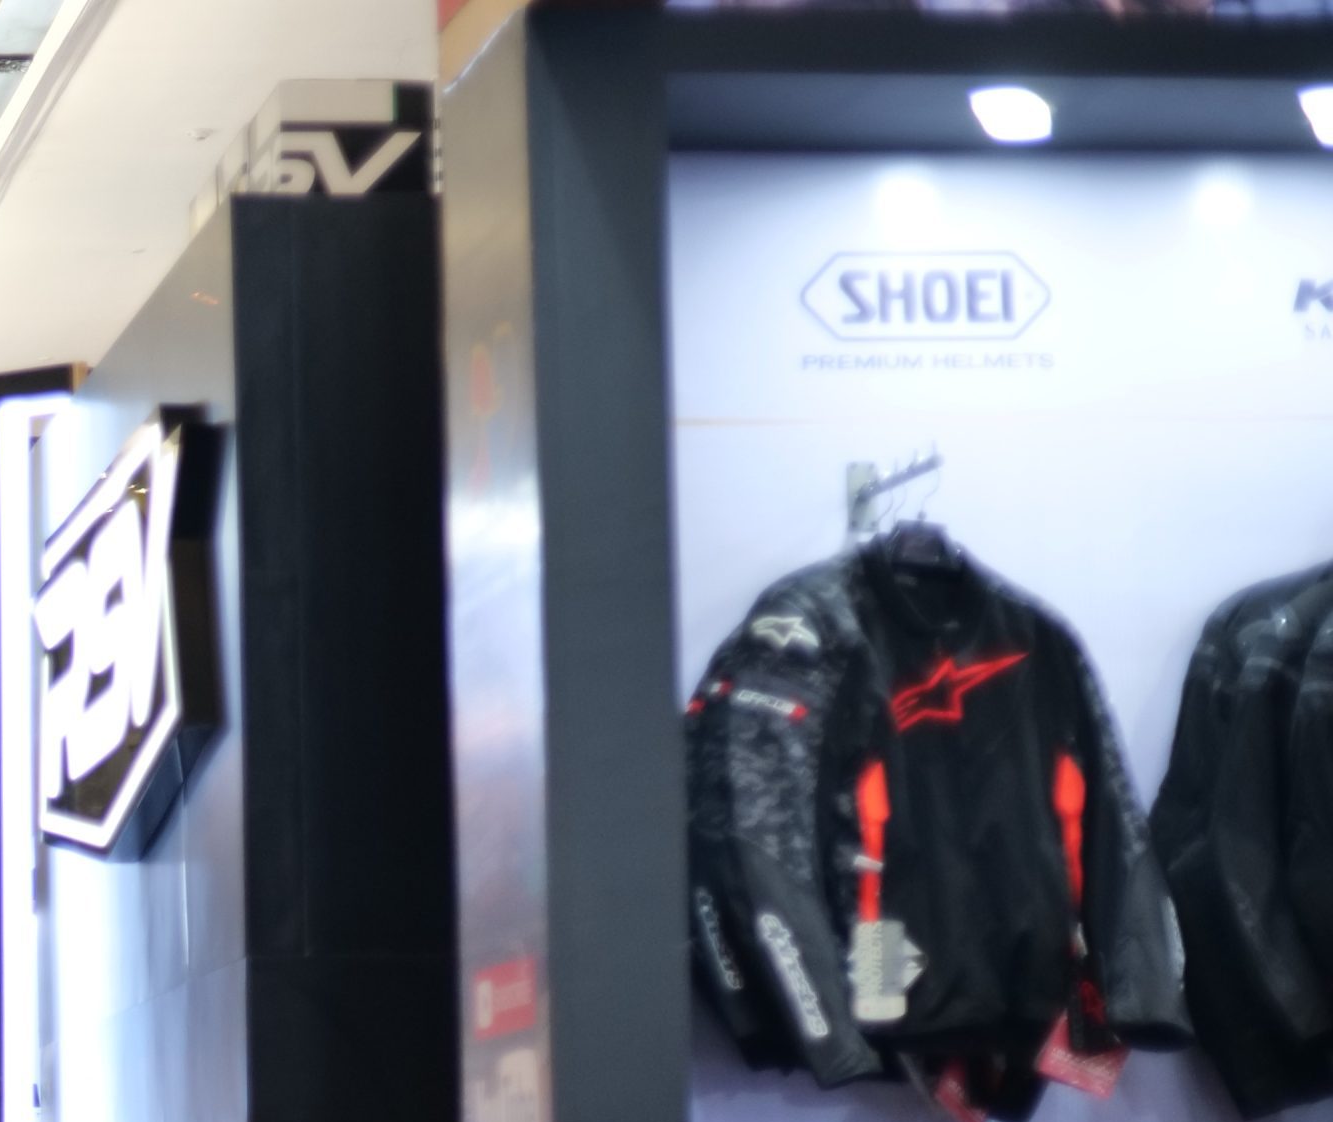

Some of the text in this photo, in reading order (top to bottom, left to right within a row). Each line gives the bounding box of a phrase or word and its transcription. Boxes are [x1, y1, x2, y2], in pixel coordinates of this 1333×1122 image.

[838, 269, 1015, 324] SHOEI
[801, 352, 1055, 371] PREMIUM HELMETS
